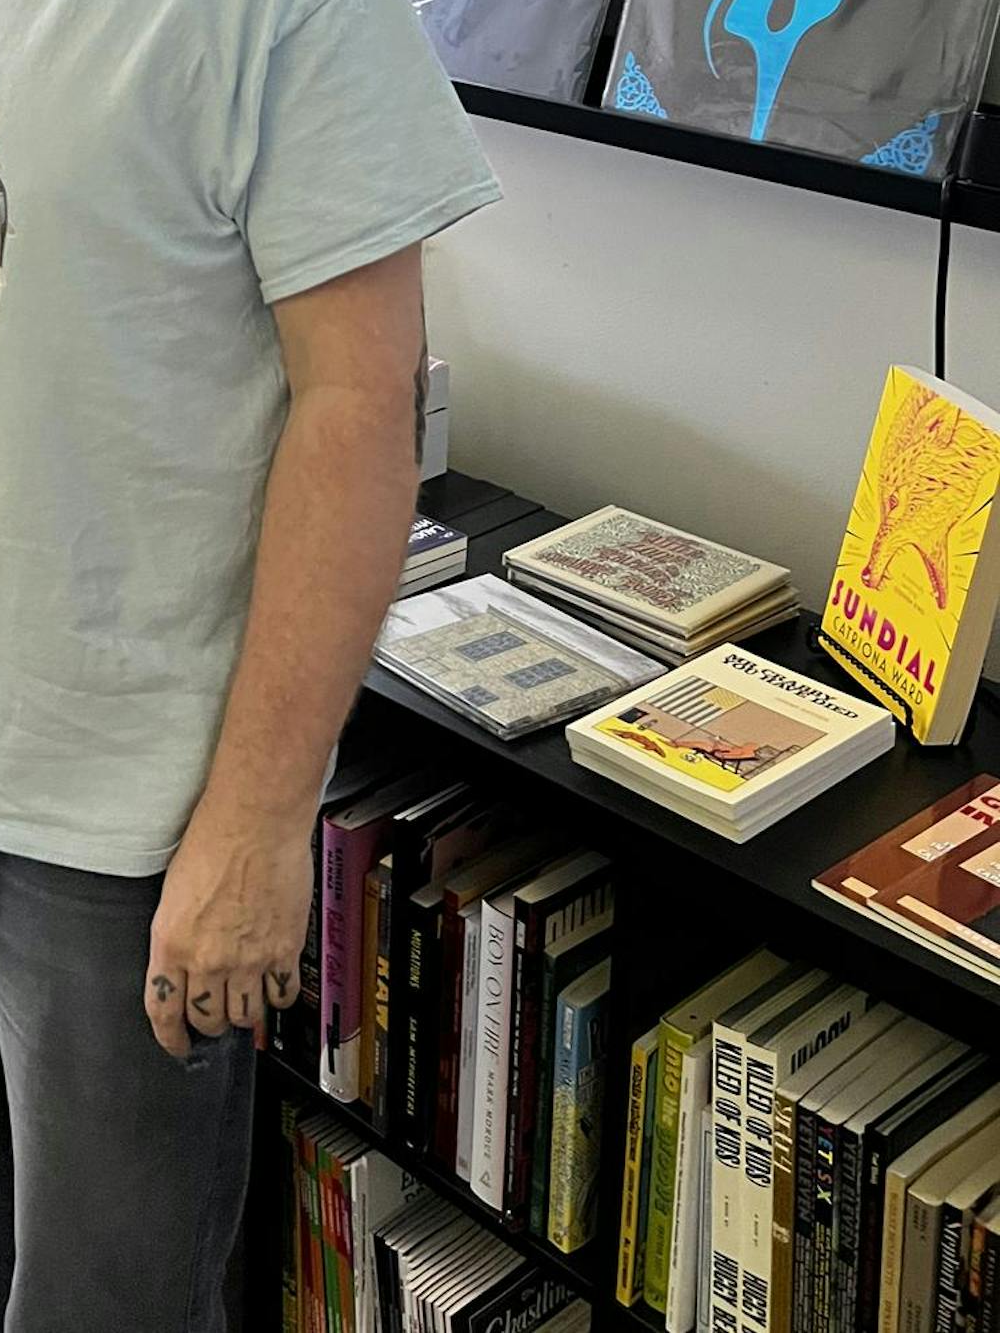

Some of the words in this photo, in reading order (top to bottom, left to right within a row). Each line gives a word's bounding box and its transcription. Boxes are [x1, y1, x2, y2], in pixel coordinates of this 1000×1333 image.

[831, 579, 937, 696] SUNDIAL
[832, 616, 888, 672] CATRIONA
[891, 665, 924, 707] WARD
[722, 658, 759, 676] YOU
[810, 697, 859, 719] DIED
[409, 928, 422, 991] MUTATIONS
[489, 923, 505, 969] BOY
[487, 972, 505, 1013] ON
[409, 1016, 417, 1044] SAM
[715, 1037, 742, 1096] KILLED
[746, 1055, 774, 1114] KILLED
[714, 1097, 741, 1127] (OF
[745, 1116, 773, 1144] (OF
[797, 1113, 815, 1157] YETI
[714, 1124, 741, 1170] KIDS)
[744, 1142, 773, 1188] KIDS)
[838, 1140, 858, 1182] YETI
[797, 1156, 815, 1223] ELEVEN
[838, 1181, 858, 1251] ELEVEN
[712, 1250, 739, 1303] HUGGY
[741, 1269, 768, 1328] HUGGY
